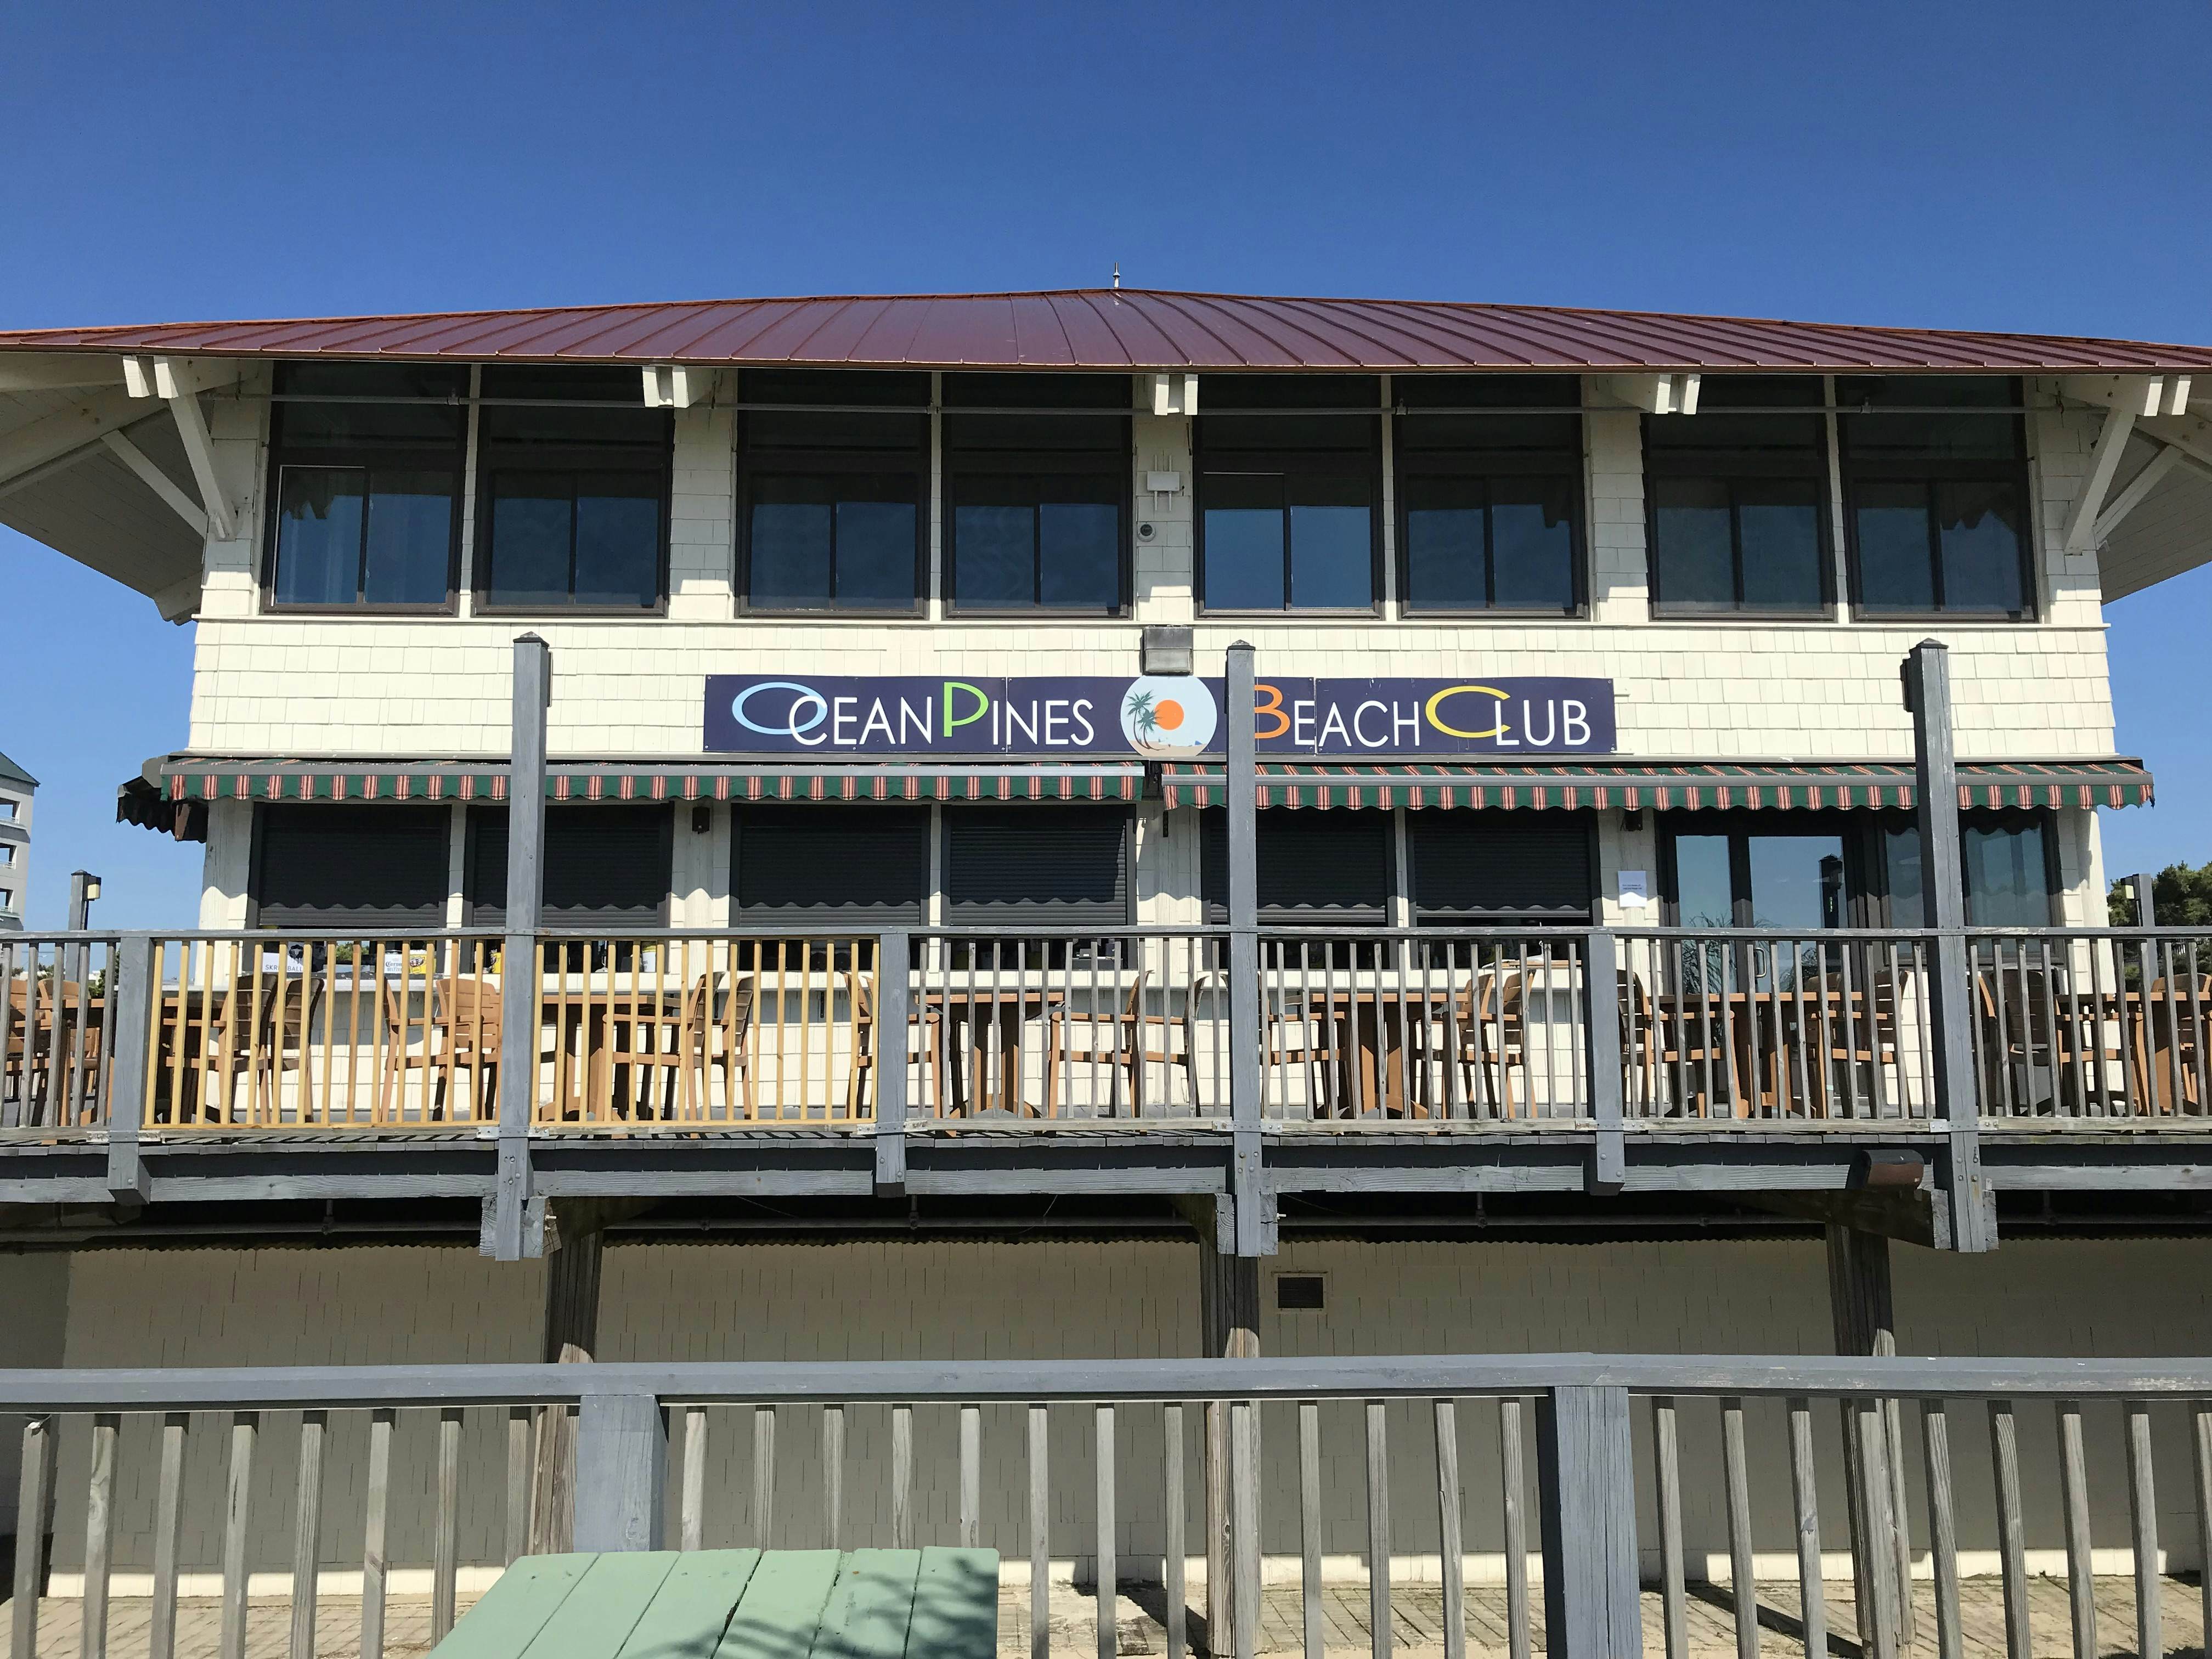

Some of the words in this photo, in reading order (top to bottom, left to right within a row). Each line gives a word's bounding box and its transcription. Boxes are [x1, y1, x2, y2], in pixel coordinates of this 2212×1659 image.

[732, 681, 932, 746] OCEAN
[944, 681, 1094, 746] PINES
[1254, 684, 1420, 747] BEACH
[1425, 685, 1591, 746] CLUB
